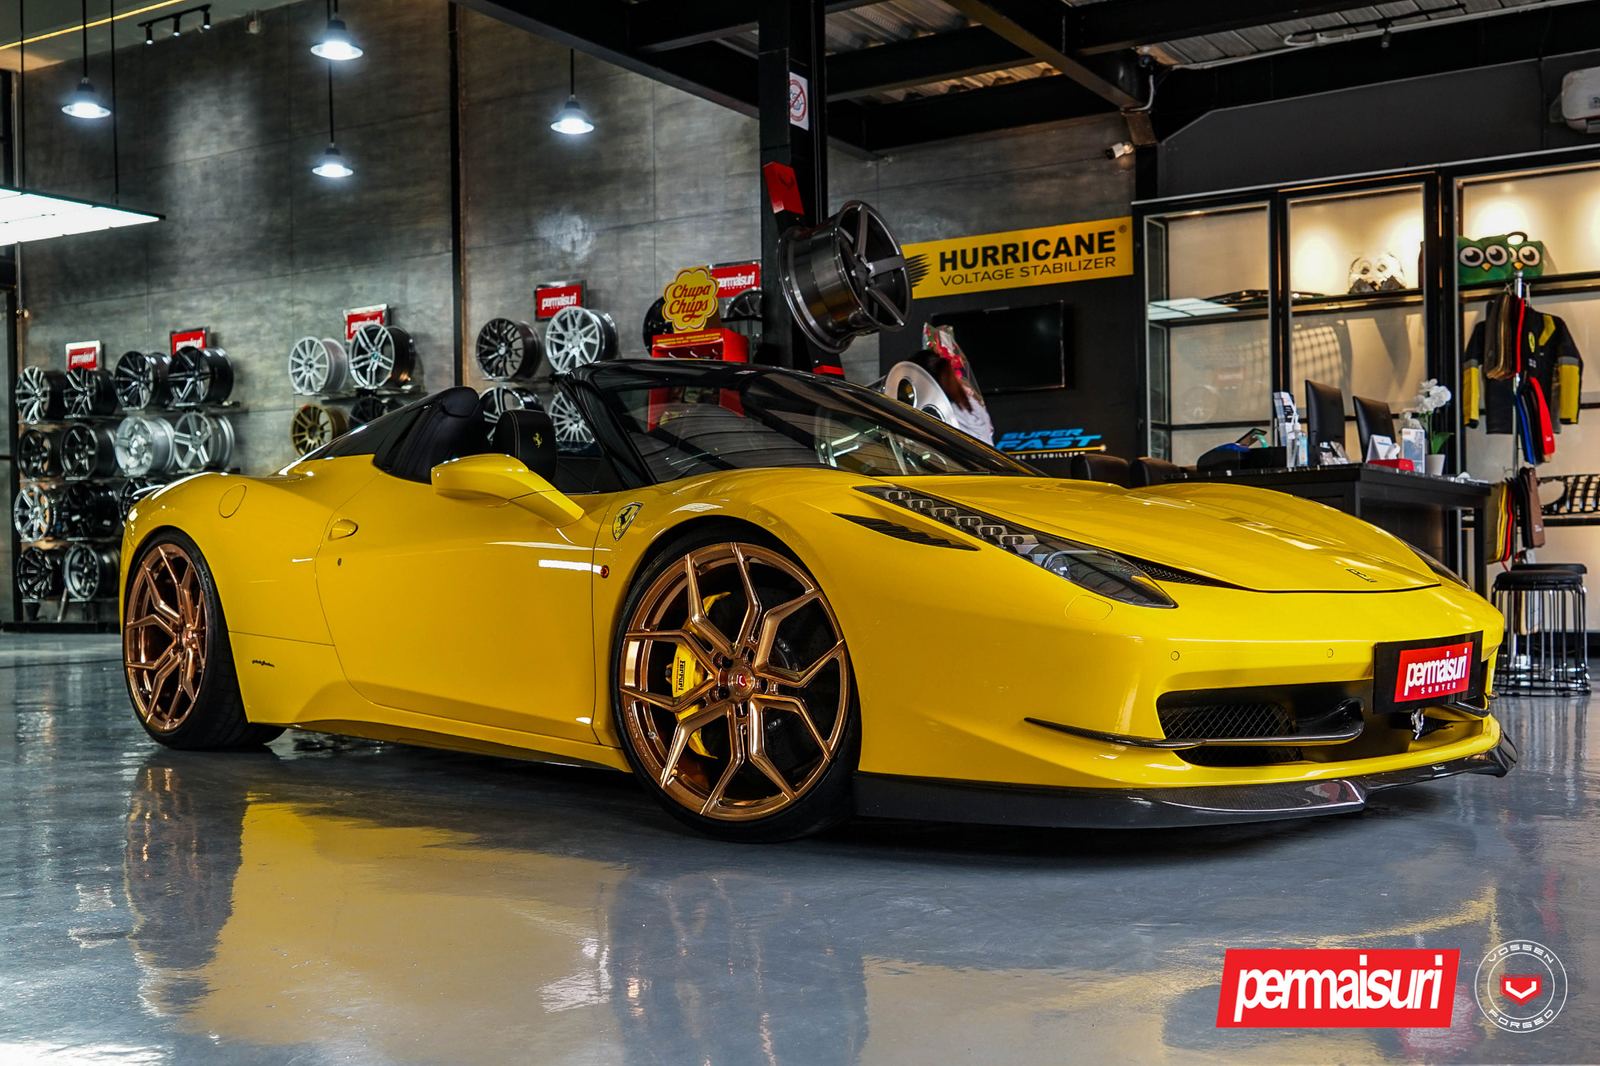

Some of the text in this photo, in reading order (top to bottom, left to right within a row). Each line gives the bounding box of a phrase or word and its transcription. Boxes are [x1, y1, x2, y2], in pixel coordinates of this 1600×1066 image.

[939, 230, 1116, 273] HURRICANE
[940, 256, 1116, 287] VOLTAGE STABILIZER
[672, 284, 712, 301] Chupa
[669, 299, 709, 323] Chups
[995, 435, 1102, 451] FAST
[1001, 428, 1084, 441] SUPER
[1403, 647, 1468, 697] permaisuri
